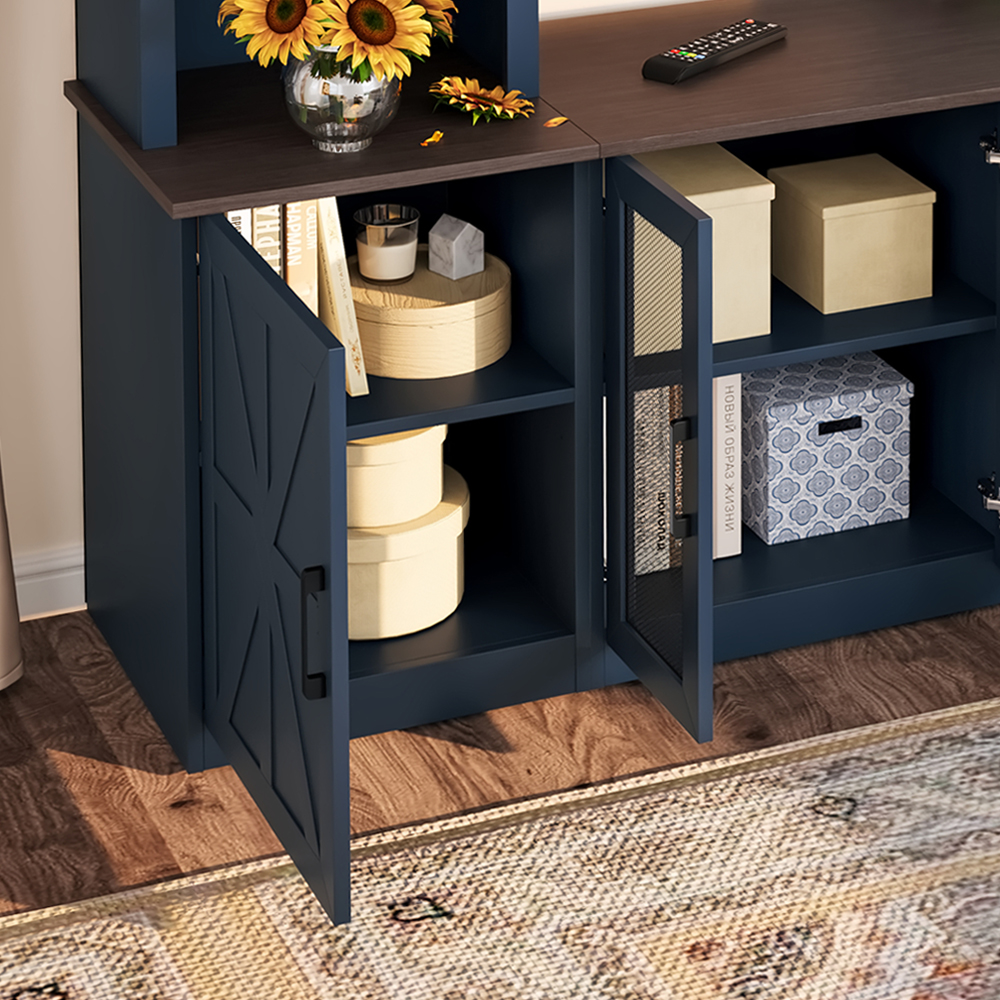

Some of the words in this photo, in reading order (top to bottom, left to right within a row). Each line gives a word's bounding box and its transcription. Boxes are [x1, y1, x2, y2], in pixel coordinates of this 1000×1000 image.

[286, 204, 302, 266] HAPMAN
[306, 206, 317, 250] CALLUM
[724, 385, 736, 434] НОВЫЙ
[724, 437, 735, 480] ОБРАЗ
[724, 483, 735, 532] ЖИЗНИ
